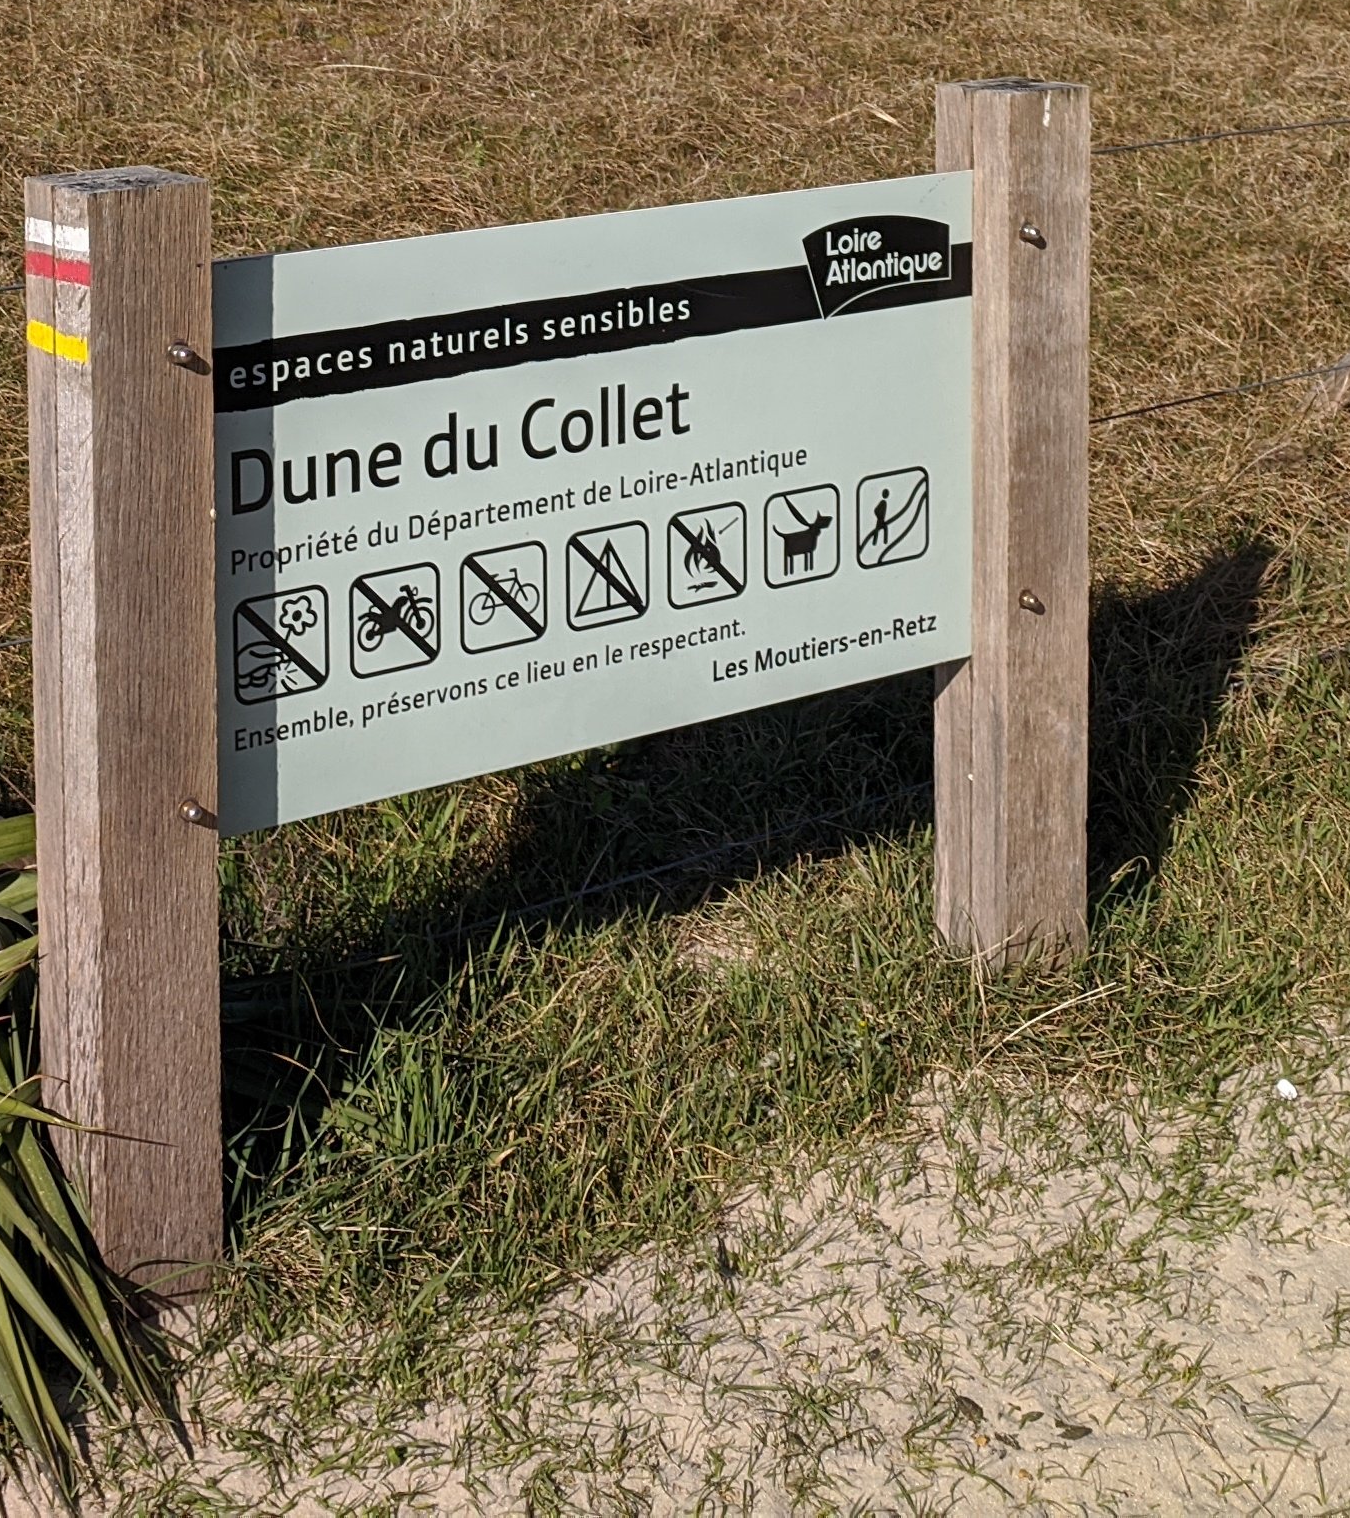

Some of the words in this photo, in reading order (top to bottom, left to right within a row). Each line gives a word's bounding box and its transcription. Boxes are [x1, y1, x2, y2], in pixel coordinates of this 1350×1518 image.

[825, 227, 882, 257] Loire
[825, 251, 943, 287] Atlantique
[229, 344, 373, 391] espaces
[388, 317, 529, 364] naturels
[542, 296, 691, 340] sensibles
[230, 439, 403, 516] Dune
[423, 411, 499, 479] du
[520, 382, 691, 461] Collet
[230, 527, 359, 576] Propriété
[367, 520, 400, 549] du
[408, 489, 576, 541] Département
[583, 480, 612, 506] de
[620, 448, 808, 500] Loire-Atlantique
[234, 706, 355, 752] Ensemble,
[361, 678, 488, 728] préservons
[494, 669, 520, 691] ce
[526, 660, 566, 685] lieu
[572, 652, 599, 674] en
[605, 644, 624, 667] le
[629, 618, 747, 661] respectant.
[712, 659, 749, 683] Les
[754, 614, 937, 673] Moutiers-en-Retz
